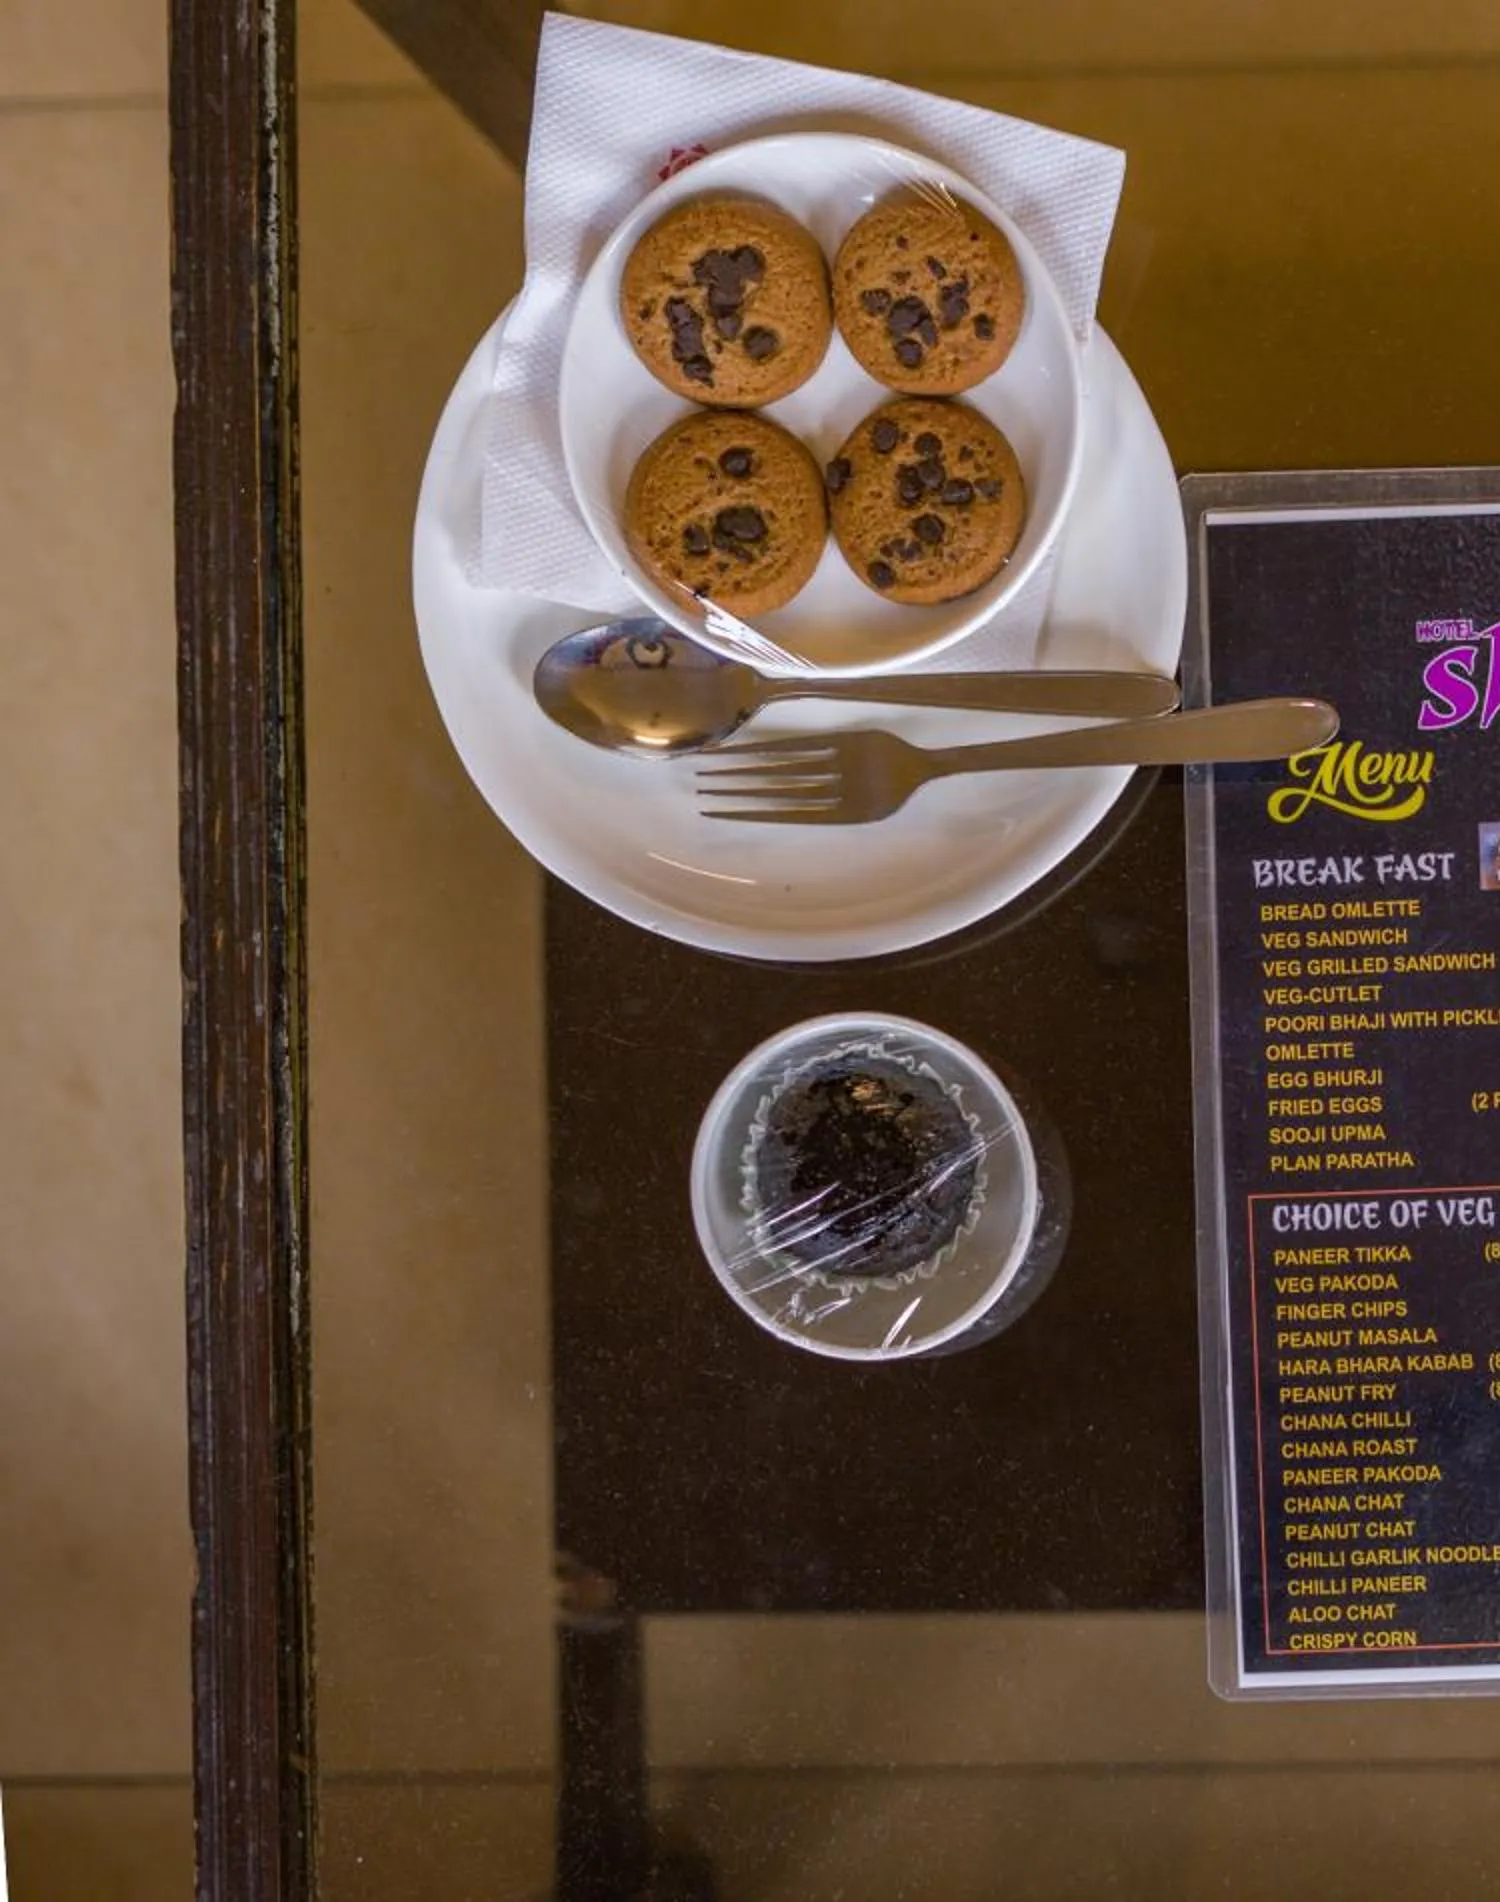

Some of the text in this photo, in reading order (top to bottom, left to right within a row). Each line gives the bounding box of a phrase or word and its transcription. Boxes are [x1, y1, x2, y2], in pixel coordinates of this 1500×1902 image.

[1415, 619, 1478, 642] HOTEL
[1267, 741, 1434, 824] Menu
[1252, 851, 1455, 888] BREAK FAST
[1260, 902, 1327, 922] BREAD
[1330, 899, 1421, 920] OMLETTE
[1262, 959, 1302, 978] VEG
[1306, 956, 1389, 976] GRILLED
[1392, 952, 1495, 973] SANDWICH
[1263, 984, 1382, 1005] VEG-CUTLET
[1264, 1014, 1325, 1033] POORI
[1328, 1012, 1385, 1031] BHAJI
[1389, 1010, 1438, 1028] WITH
[1267, 1097, 1324, 1116] FRIED
[1328, 1095, 1383, 1114] EGGS
[1270, 1154, 1322, 1172] PLAN
[1325, 1150, 1415, 1169] PARATHA
[1271, 1200, 1381, 1233] CHOICE
[1389, 1198, 1429, 1228] OF
[1435, 1196, 1495, 1227] VEG
[1273, 1246, 1350, 1265] PANEER
[1354, 1245, 1412, 1263] TIKKA
[1275, 1302, 1346, 1321] FINGER
[1350, 1300, 1408, 1318] CHIPS
[1278, 1358, 1332, 1376] HARA
[1334, 1355, 1404, 1375] BHARA
[1406, 1353, 1474, 1371] KABAB
[1279, 1413, 1347, 1431] CHANA
[1350, 1411, 1411, 1429] CHILLI
[1284, 1521, 1361, 1541] PEANUT
[1364, 1520, 1416, 1538] CHAT
[1285, 1551, 1346, 1569] CHILLI
[1349, 1547, 1421, 1566] GARLIK
[1287, 1605, 1342, 1623] ALOO
[1344, 1602, 1396, 1621] CHAT
[1289, 1631, 1357, 1650] CRISPY
[1362, 1630, 1417, 1650] CORN
